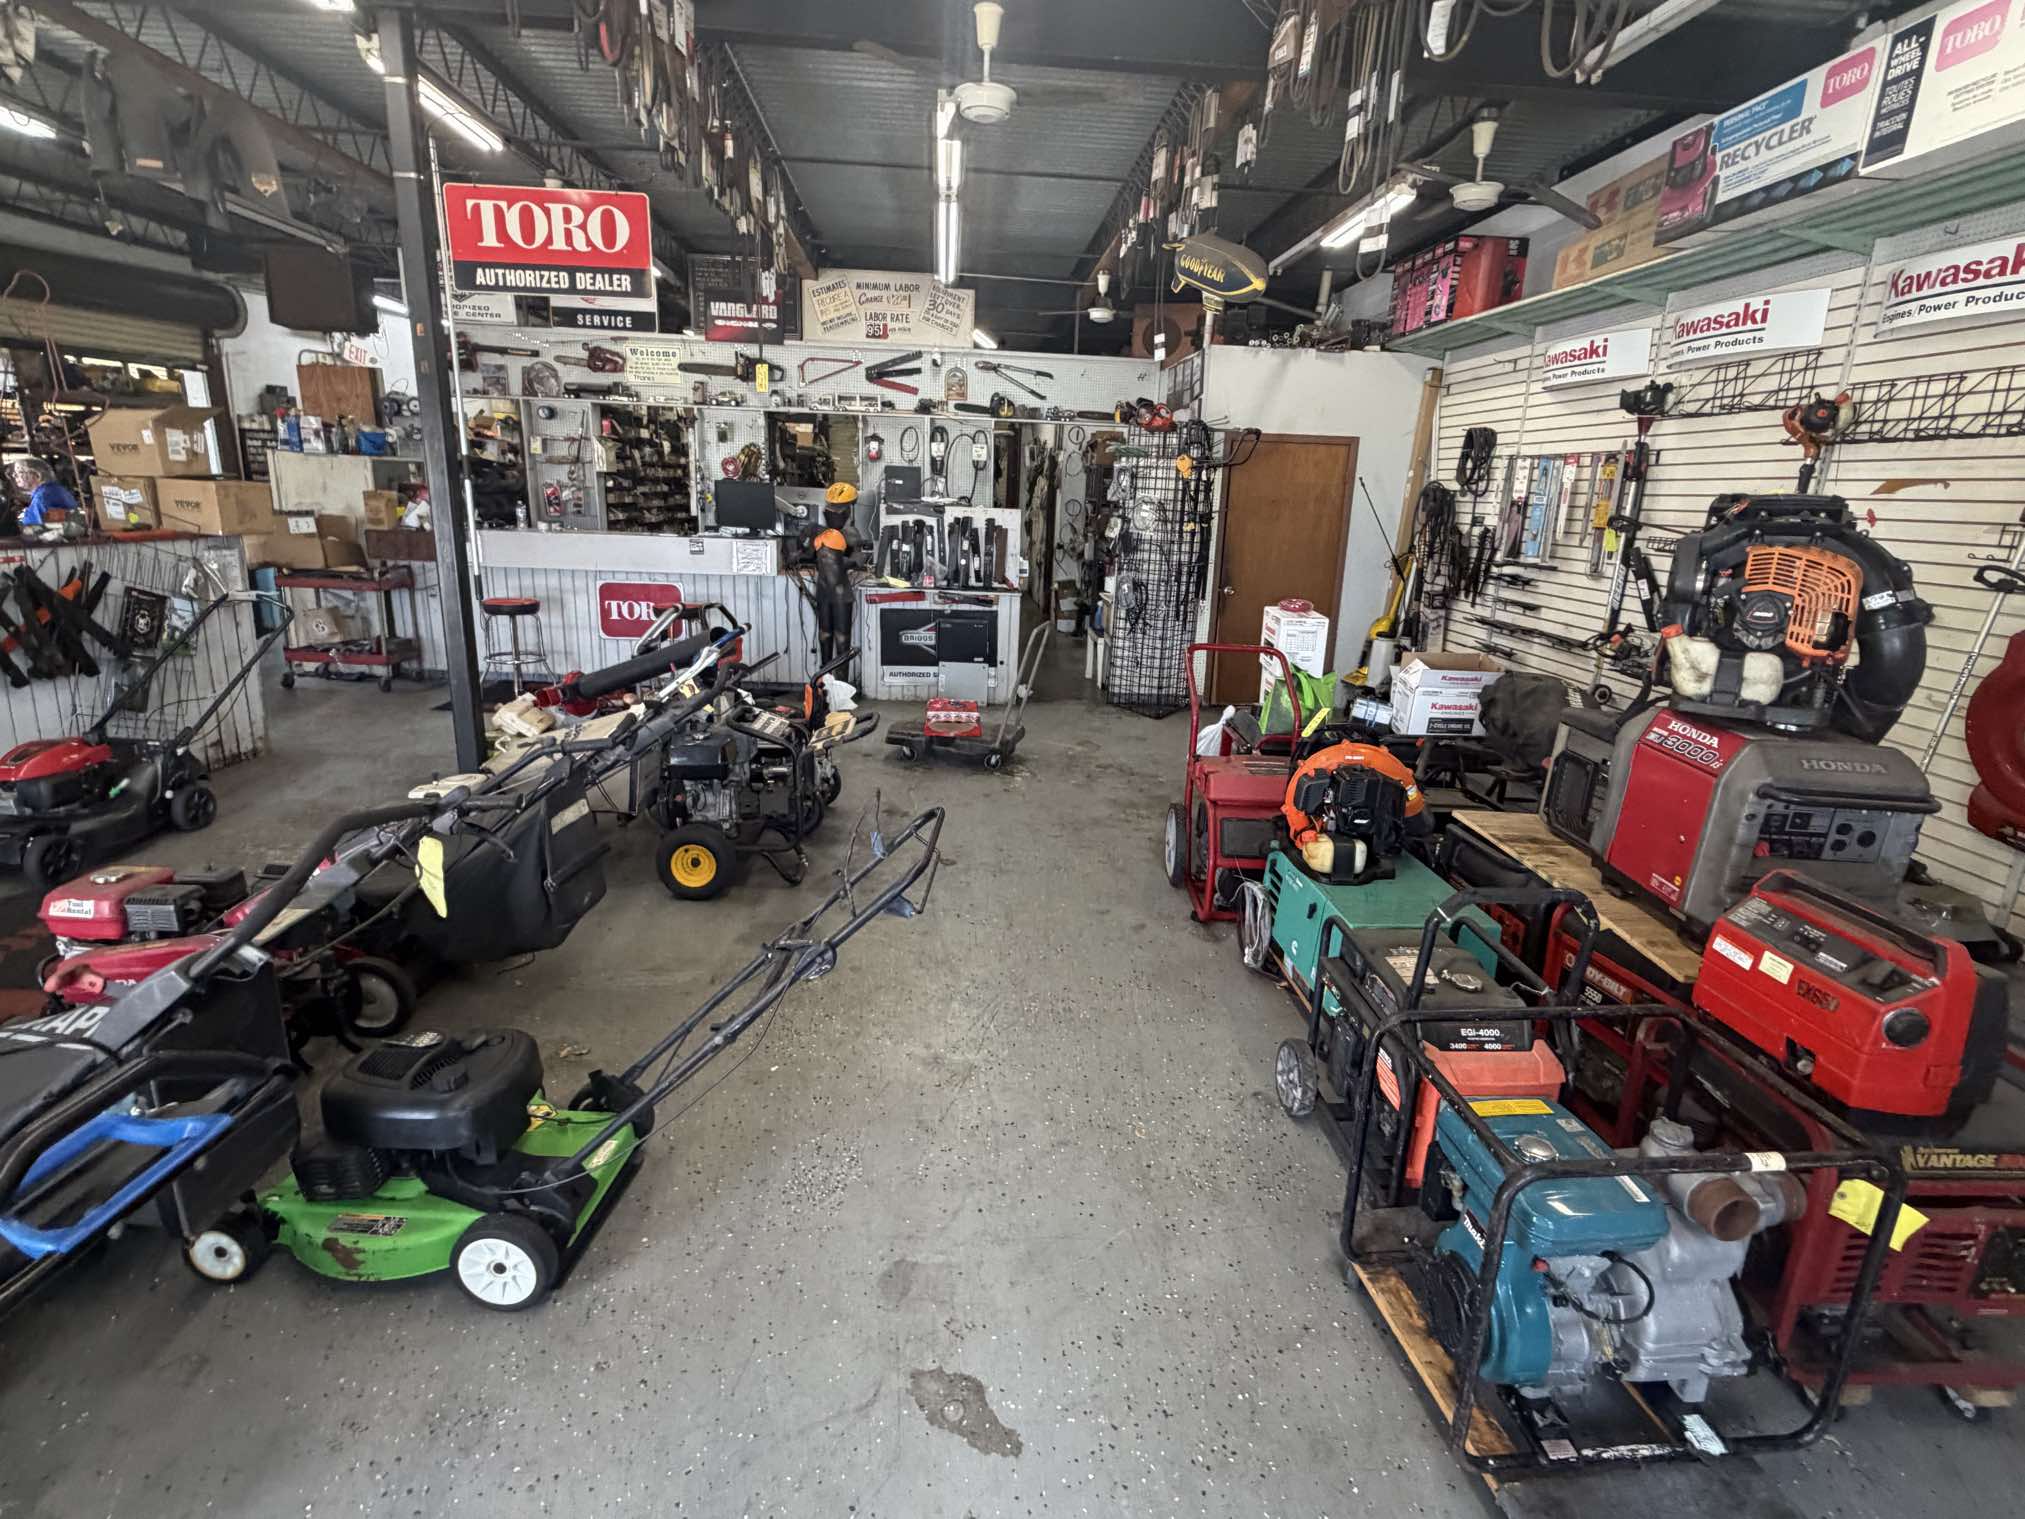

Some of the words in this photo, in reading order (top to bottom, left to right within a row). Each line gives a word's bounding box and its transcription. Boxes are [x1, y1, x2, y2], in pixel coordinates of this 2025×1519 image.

[1943, 14, 2000, 56] TORO
[1890, 49, 1922, 68] WHEEL
[1887, 57, 1922, 81] DRIVE
[1827, 61, 1870, 94] TORO
[1719, 117, 1815, 172] RECYCLER
[465, 198, 630, 253] TORO
[1180, 254, 1226, 284] GOODYEAR
[475, 267, 569, 289] AUTHORIZED
[576, 272, 632, 292] DEALER
[856, 281, 891, 292] MINIMUM
[894, 283, 921, 293] LABOR
[811, 280, 847, 298] ESTIMATES
[1964, 290, 2025, 307] Produc
[465, 311, 501, 319] CENTER
[927, 301, 945, 314] 30
[576, 314, 633, 328] SERVICE
[865, 311, 888, 322] LABOR
[890, 312, 911, 323] RATE
[1714, 335, 1765, 350] Products
[348, 344, 368, 366] EXIT
[629, 348, 677, 358] Welcome
[1570, 367, 1606, 378] Products
[605, 600, 657, 622] TOR
[903, 634, 935, 643] BRIGGS
[889, 671, 931, 679] AUTHORIZED
[1430, 702, 1478, 711] Kawasaki
[1667, 720, 1719, 748] HONDA
[1800, 759, 1888, 774] HONDA
[67, 907, 92, 916] Rental
[1460, 1028, 1500, 1037] EGI-4000
[1449, 1042, 1467, 1050] 3400
[1484, 1042, 1502, 1050] 4000
[1916, 1154, 1998, 1168] VANTAGE
